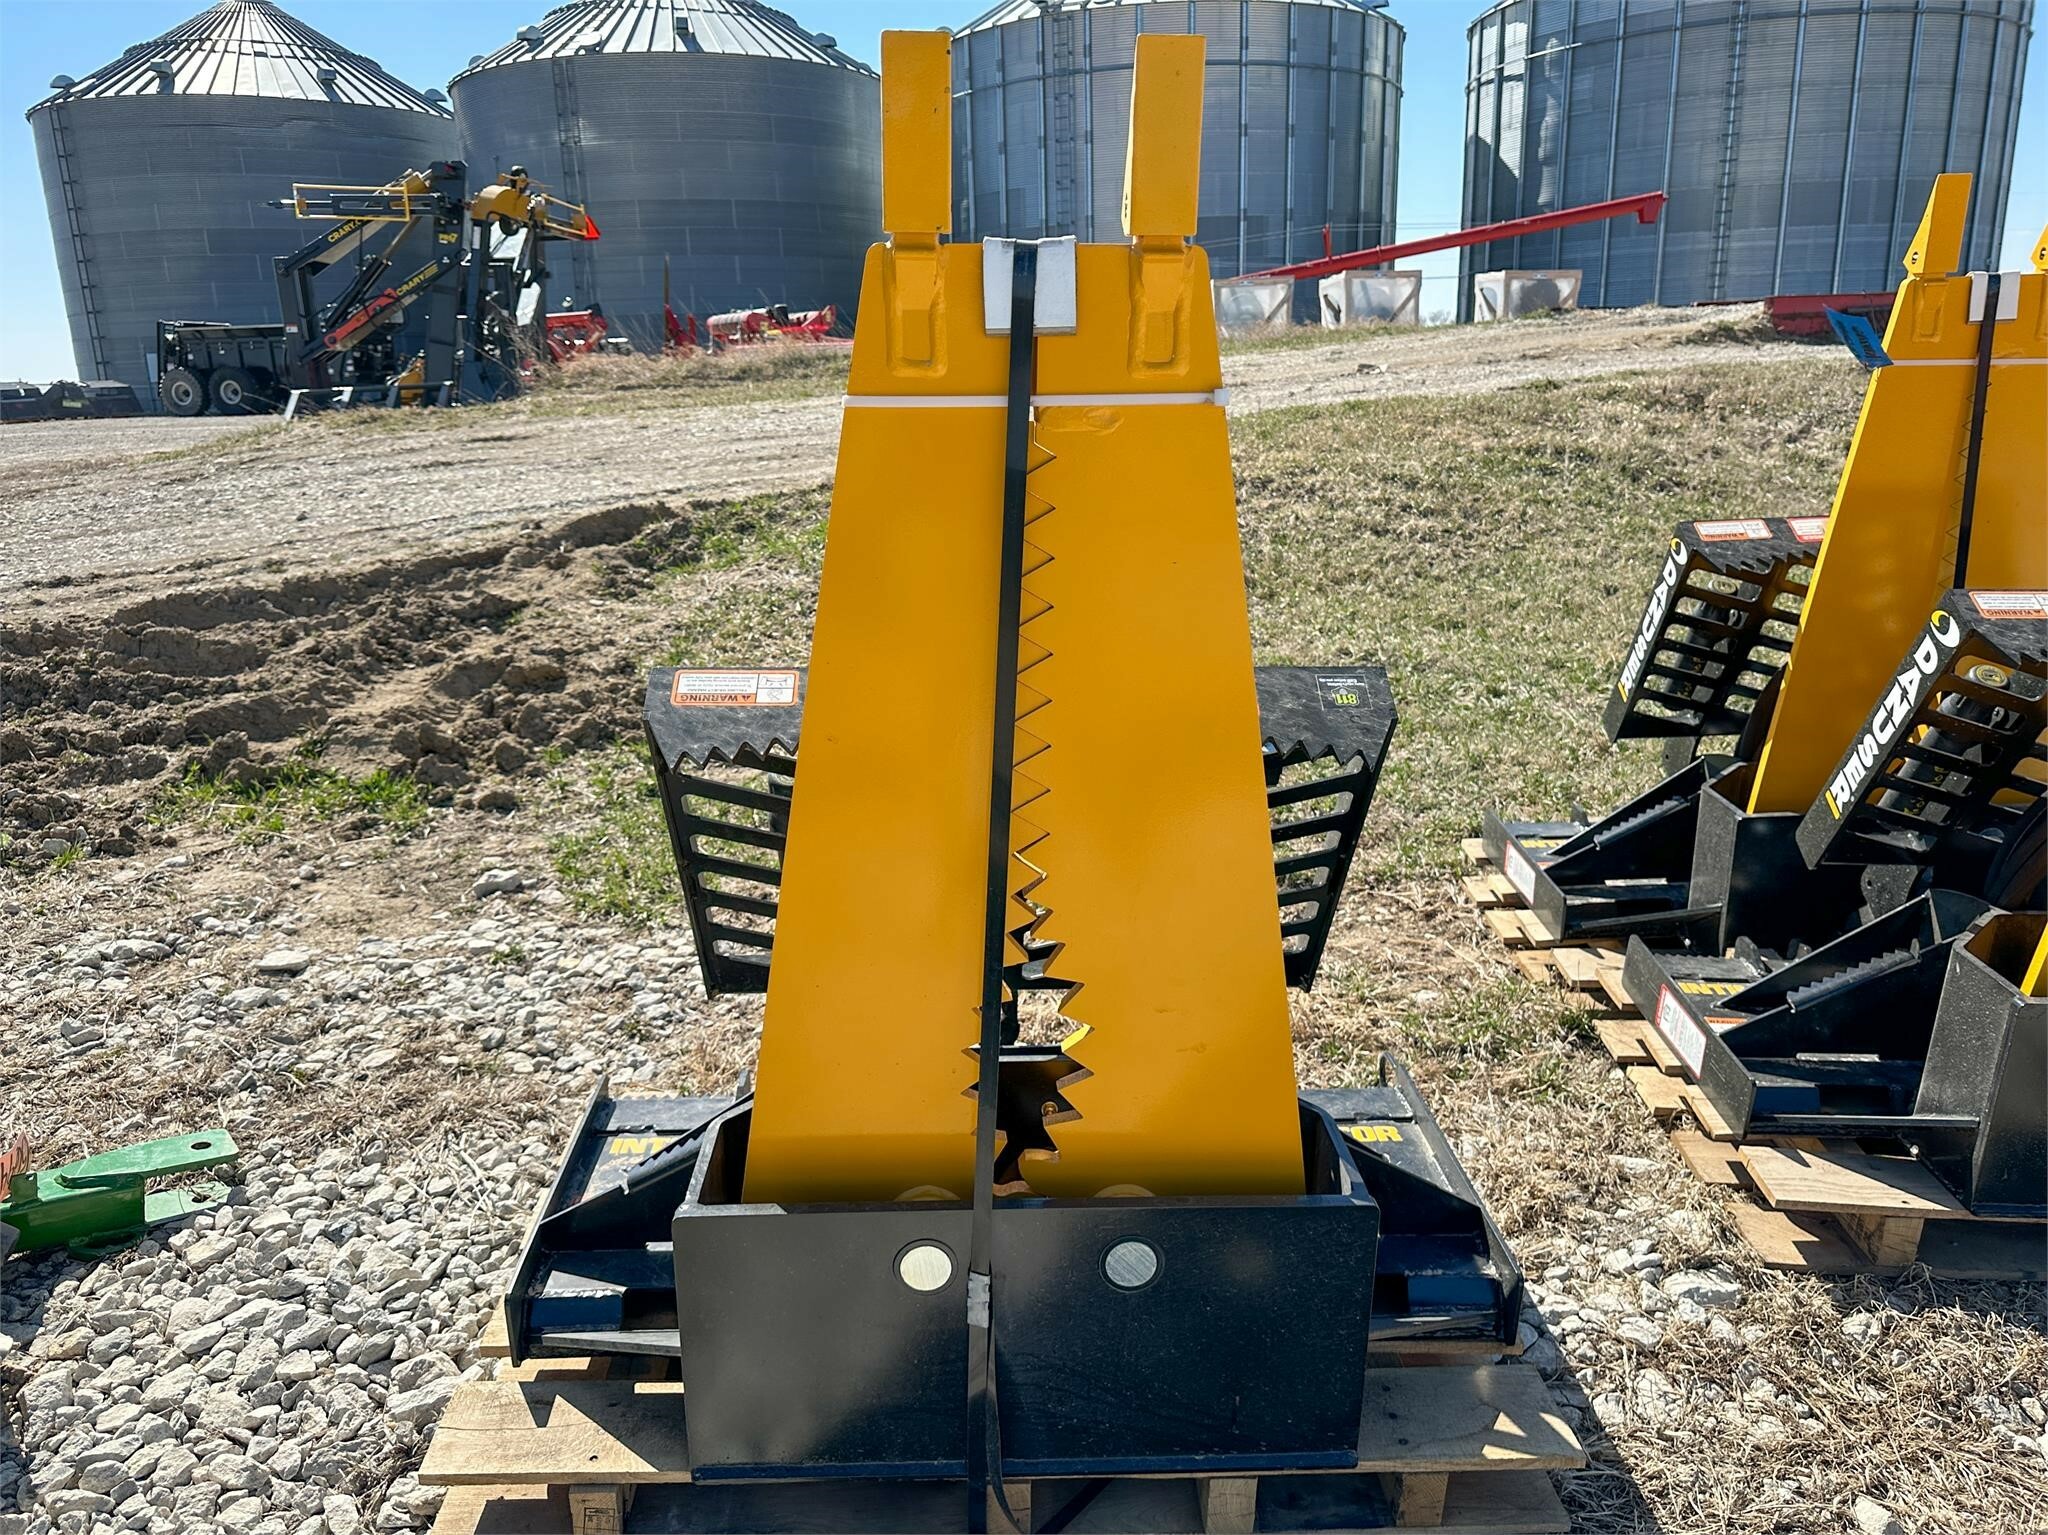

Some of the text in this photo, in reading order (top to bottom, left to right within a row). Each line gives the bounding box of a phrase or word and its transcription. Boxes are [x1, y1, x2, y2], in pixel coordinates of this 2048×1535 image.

[328, 220, 361, 243] CRARY.C
[396, 275, 426, 295] CRARY
[1619, 556, 1677, 697] DANUSER
[680, 694, 738, 702] WARNING
[1335, 693, 1358, 704] 811
[1829, 634, 1939, 814] DANUSER
[1340, 1125, 1404, 1143] OR
[608, 1137, 672, 1155] INT
